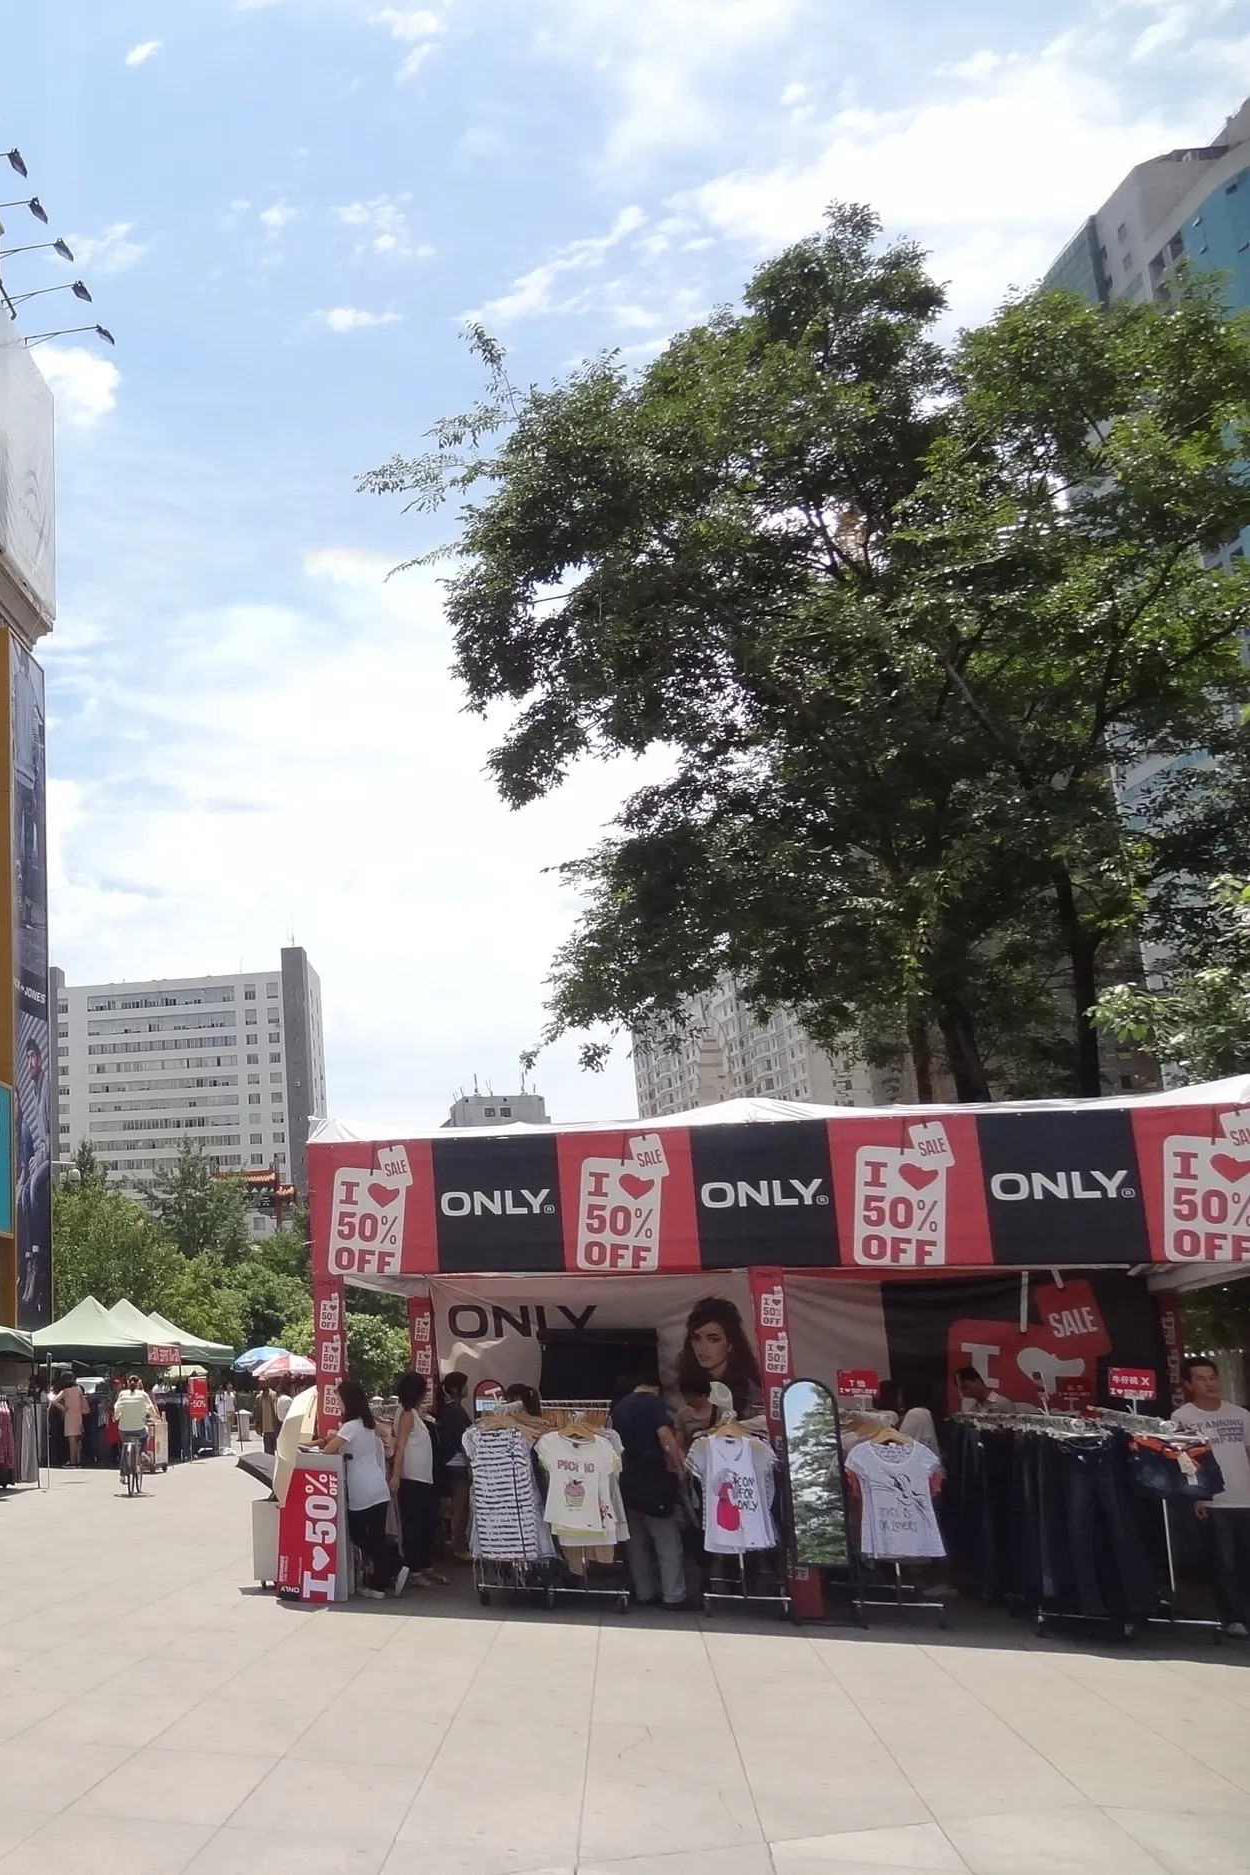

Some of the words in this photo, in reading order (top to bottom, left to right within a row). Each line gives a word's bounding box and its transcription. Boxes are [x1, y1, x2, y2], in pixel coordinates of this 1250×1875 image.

[636, 1149, 663, 1168] SALE
[918, 1137, 947, 1157] SALE
[384, 1159, 408, 1178] SALE
[863, 1160, 888, 1188] I
[1172, 1151, 1199, 1180] I
[339, 1181, 360, 1206] I
[587, 1171, 609, 1198] I
[700, 1178, 823, 1209] ONLY
[990, 1170, 1128, 1201] ONLY
[441, 1188, 551, 1217] ONLY
[862, 1194, 938, 1232] 50%
[337, 1211, 398, 1245] 50%
[585, 1203, 654, 1239] 50%
[334, 1246, 396, 1273] OFF
[583, 1240, 652, 1269] OFF
[861, 1234, 938, 1265] OFF
[1172, 1229, 1250, 1262] OFF
[1049, 1306, 1098, 1338] SALE
[329, 1474, 338, 1496] OFF
[305, 1473, 337, 1544] 50%
[302, 1571, 336, 1601] I
